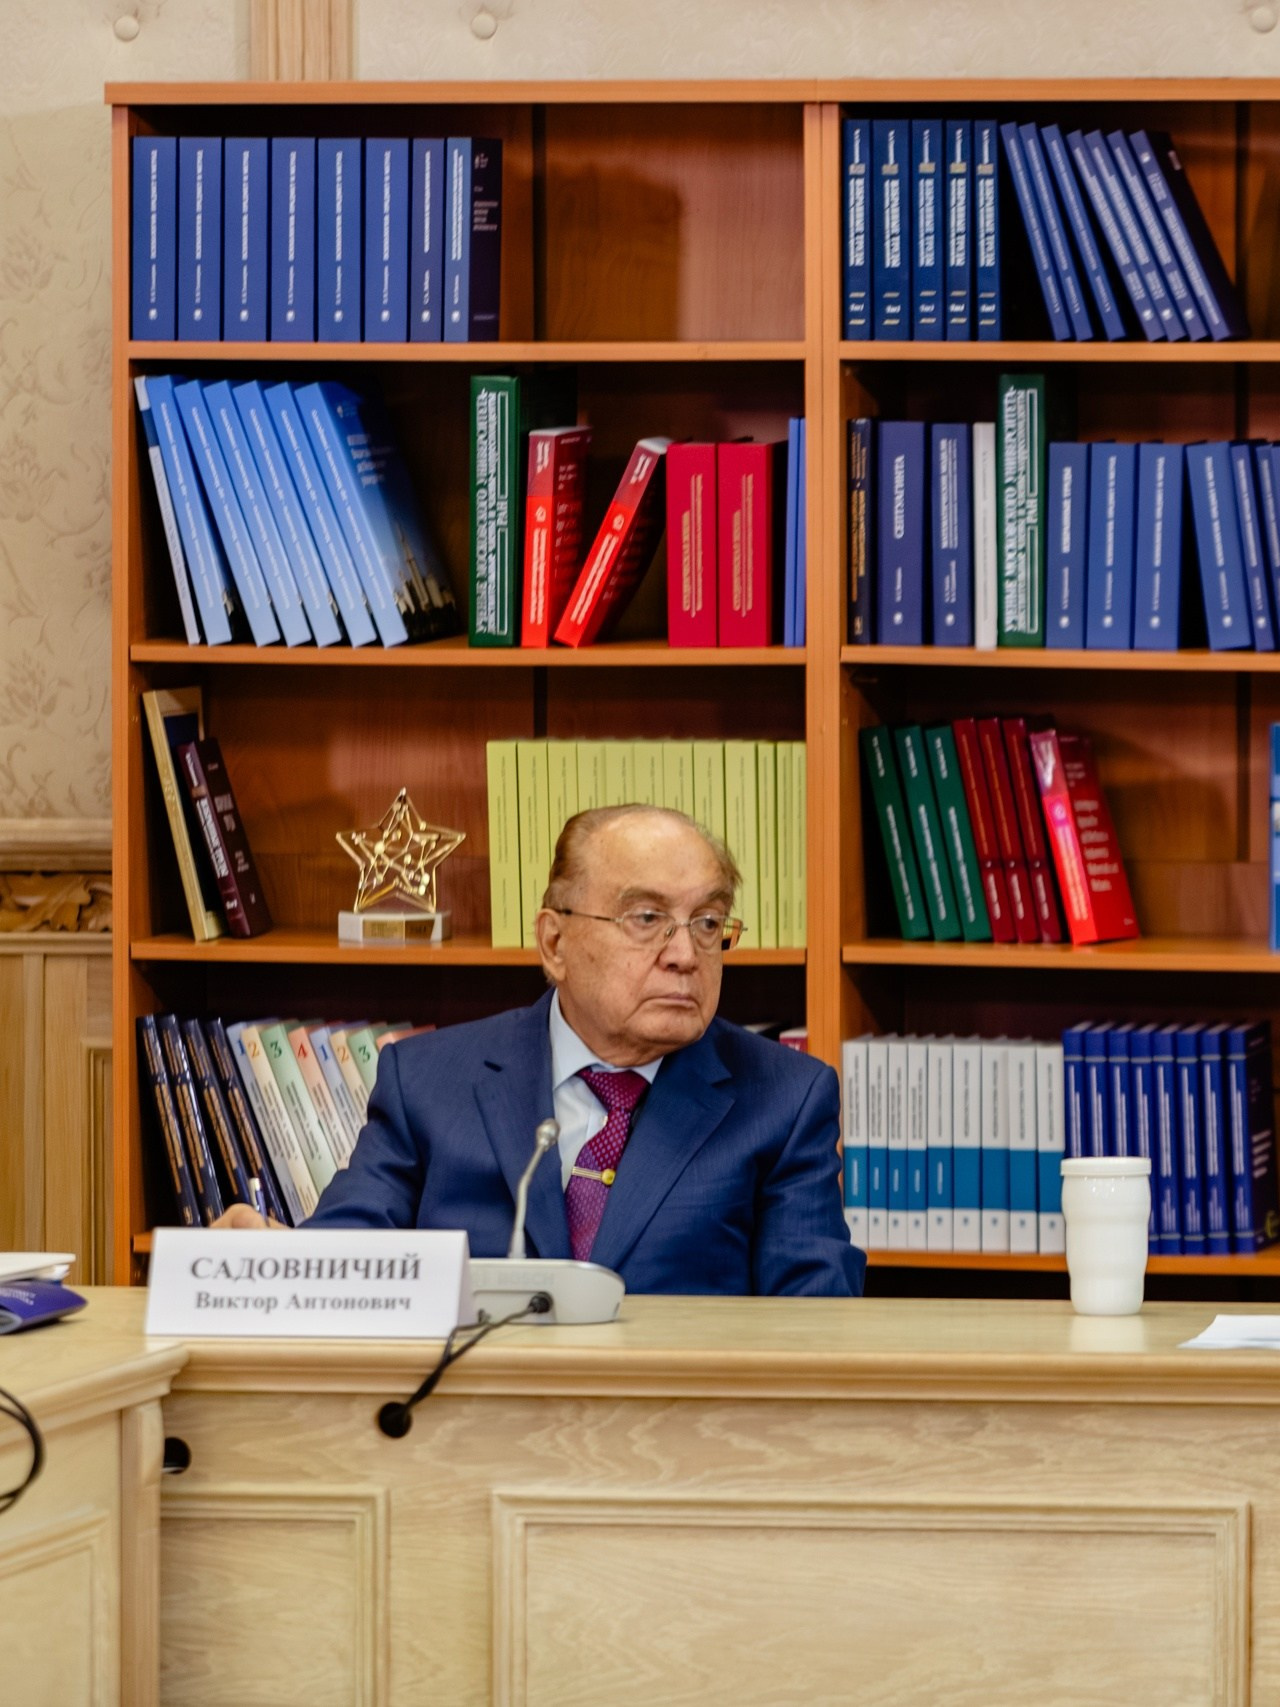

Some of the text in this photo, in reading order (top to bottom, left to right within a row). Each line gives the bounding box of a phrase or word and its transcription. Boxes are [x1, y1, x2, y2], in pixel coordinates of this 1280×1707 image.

[248, 1042, 260, 1058] 2
[270, 1041, 283, 1058] 3
[297, 1043, 308, 1058] 4
[336, 1046, 350, 1062] 2
[358, 1045, 371, 1062] 3
[190, 1256, 422, 1283] САДОВНИЧИЙ
[194, 1292, 412, 1316] Виктор Антонович
